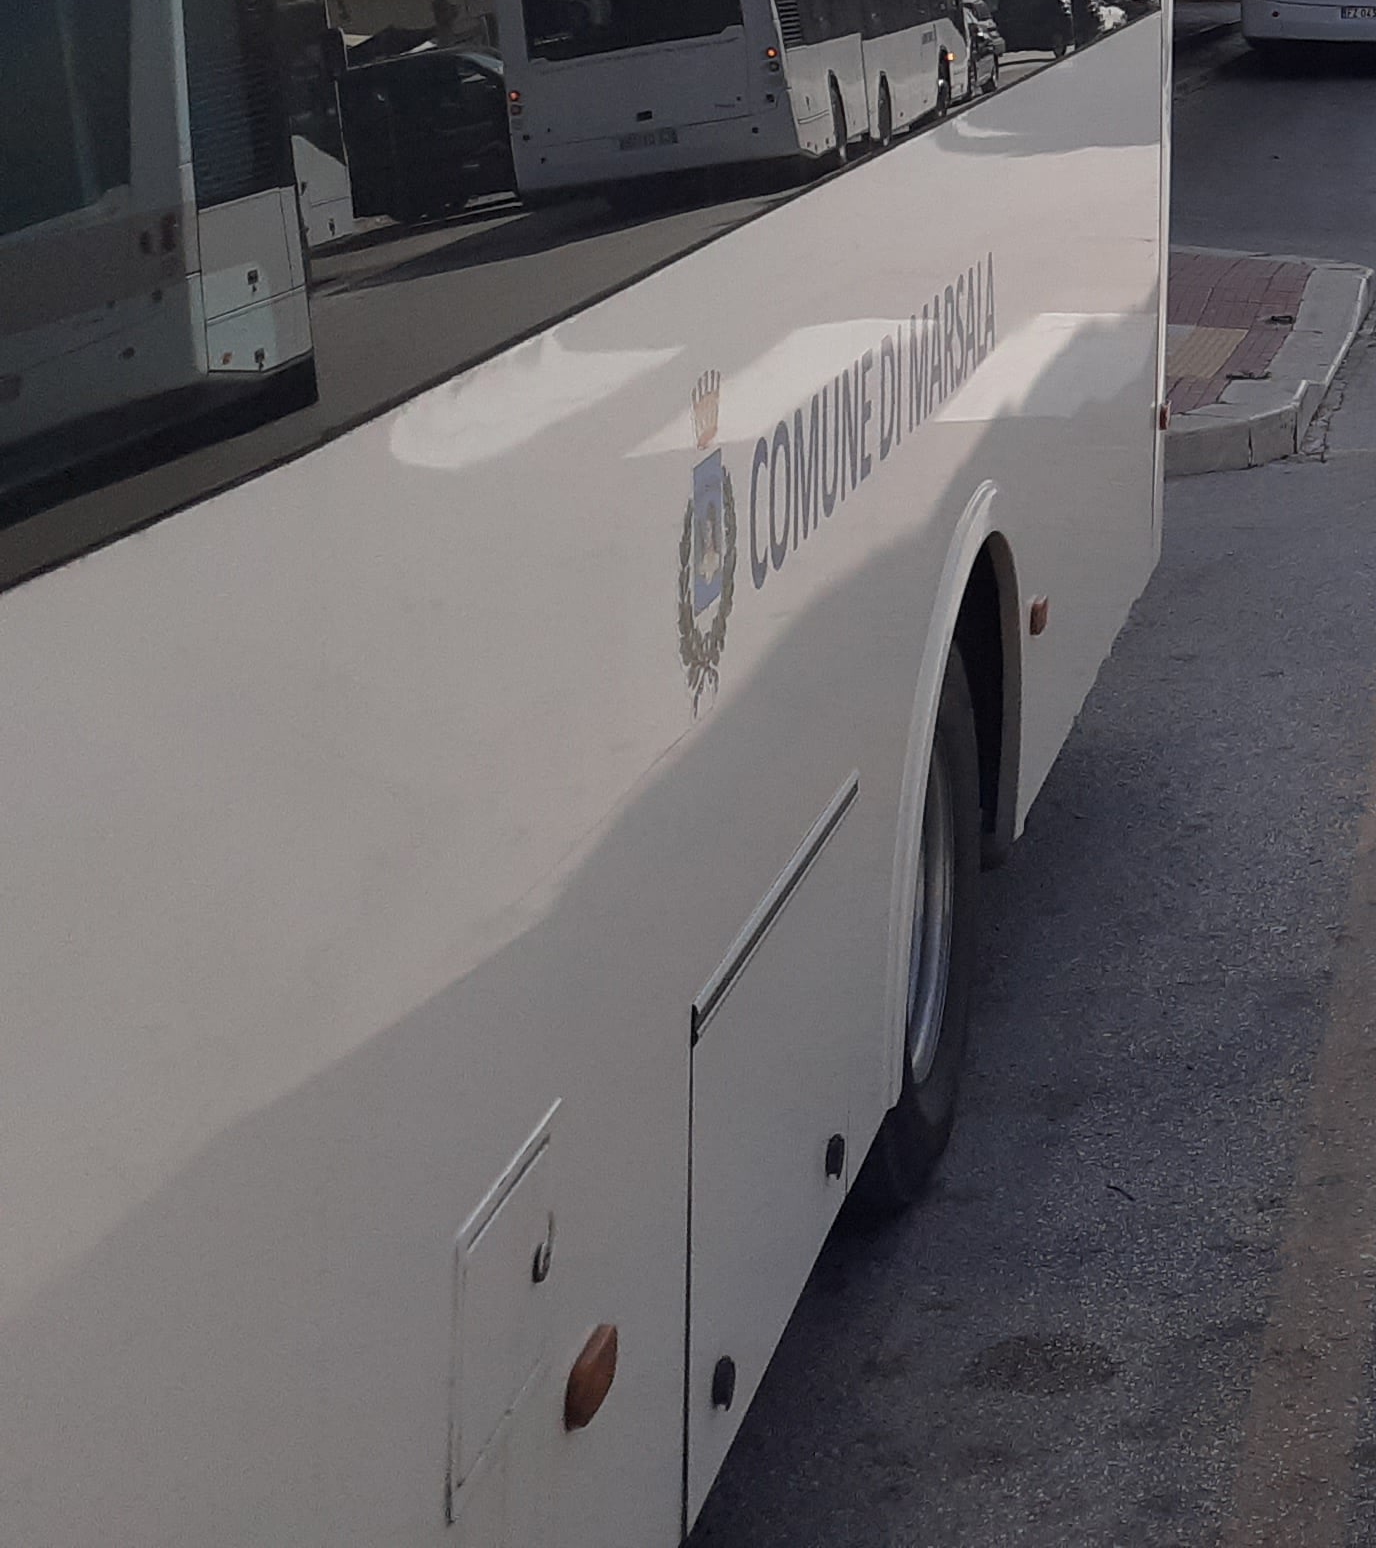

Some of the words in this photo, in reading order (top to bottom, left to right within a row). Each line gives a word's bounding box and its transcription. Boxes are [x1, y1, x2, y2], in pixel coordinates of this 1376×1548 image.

[749, 348, 873, 590] COMUNE
[879, 322, 902, 462] DI
[908, 251, 996, 434] MARSALA
